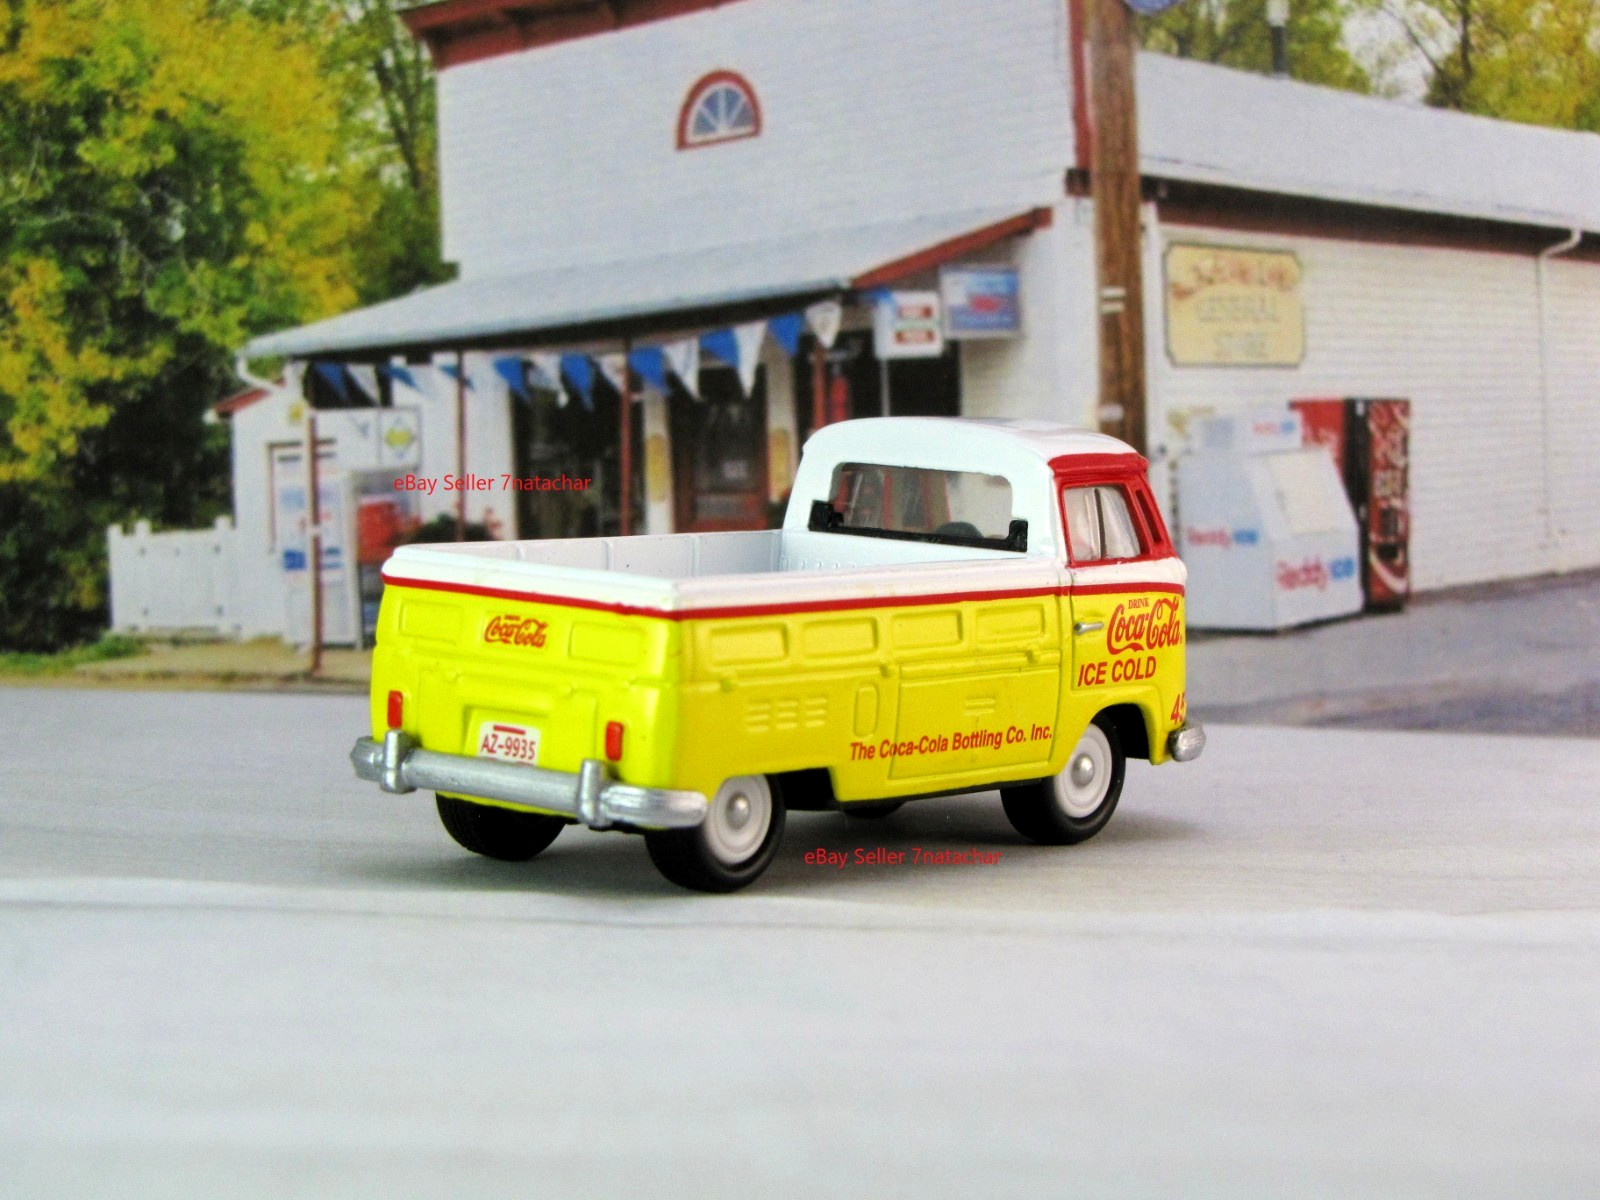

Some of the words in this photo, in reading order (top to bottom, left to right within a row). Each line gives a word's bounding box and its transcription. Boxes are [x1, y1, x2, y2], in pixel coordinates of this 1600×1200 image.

[1128, 598, 1149, 609] DRINK
[1106, 596, 1180, 655] Coca-Cola
[1077, 661, 1107, 687] ICE
[1111, 656, 1156, 682] COLD
[481, 733, 536, 760] AZ-9935
[850, 742, 875, 761] The
[879, 735, 948, 758] Coca-Cola
[952, 730, 1003, 750] Bottling
[1006, 726, 1027, 745] Co.
[1031, 723, 1053, 741] Inc.
